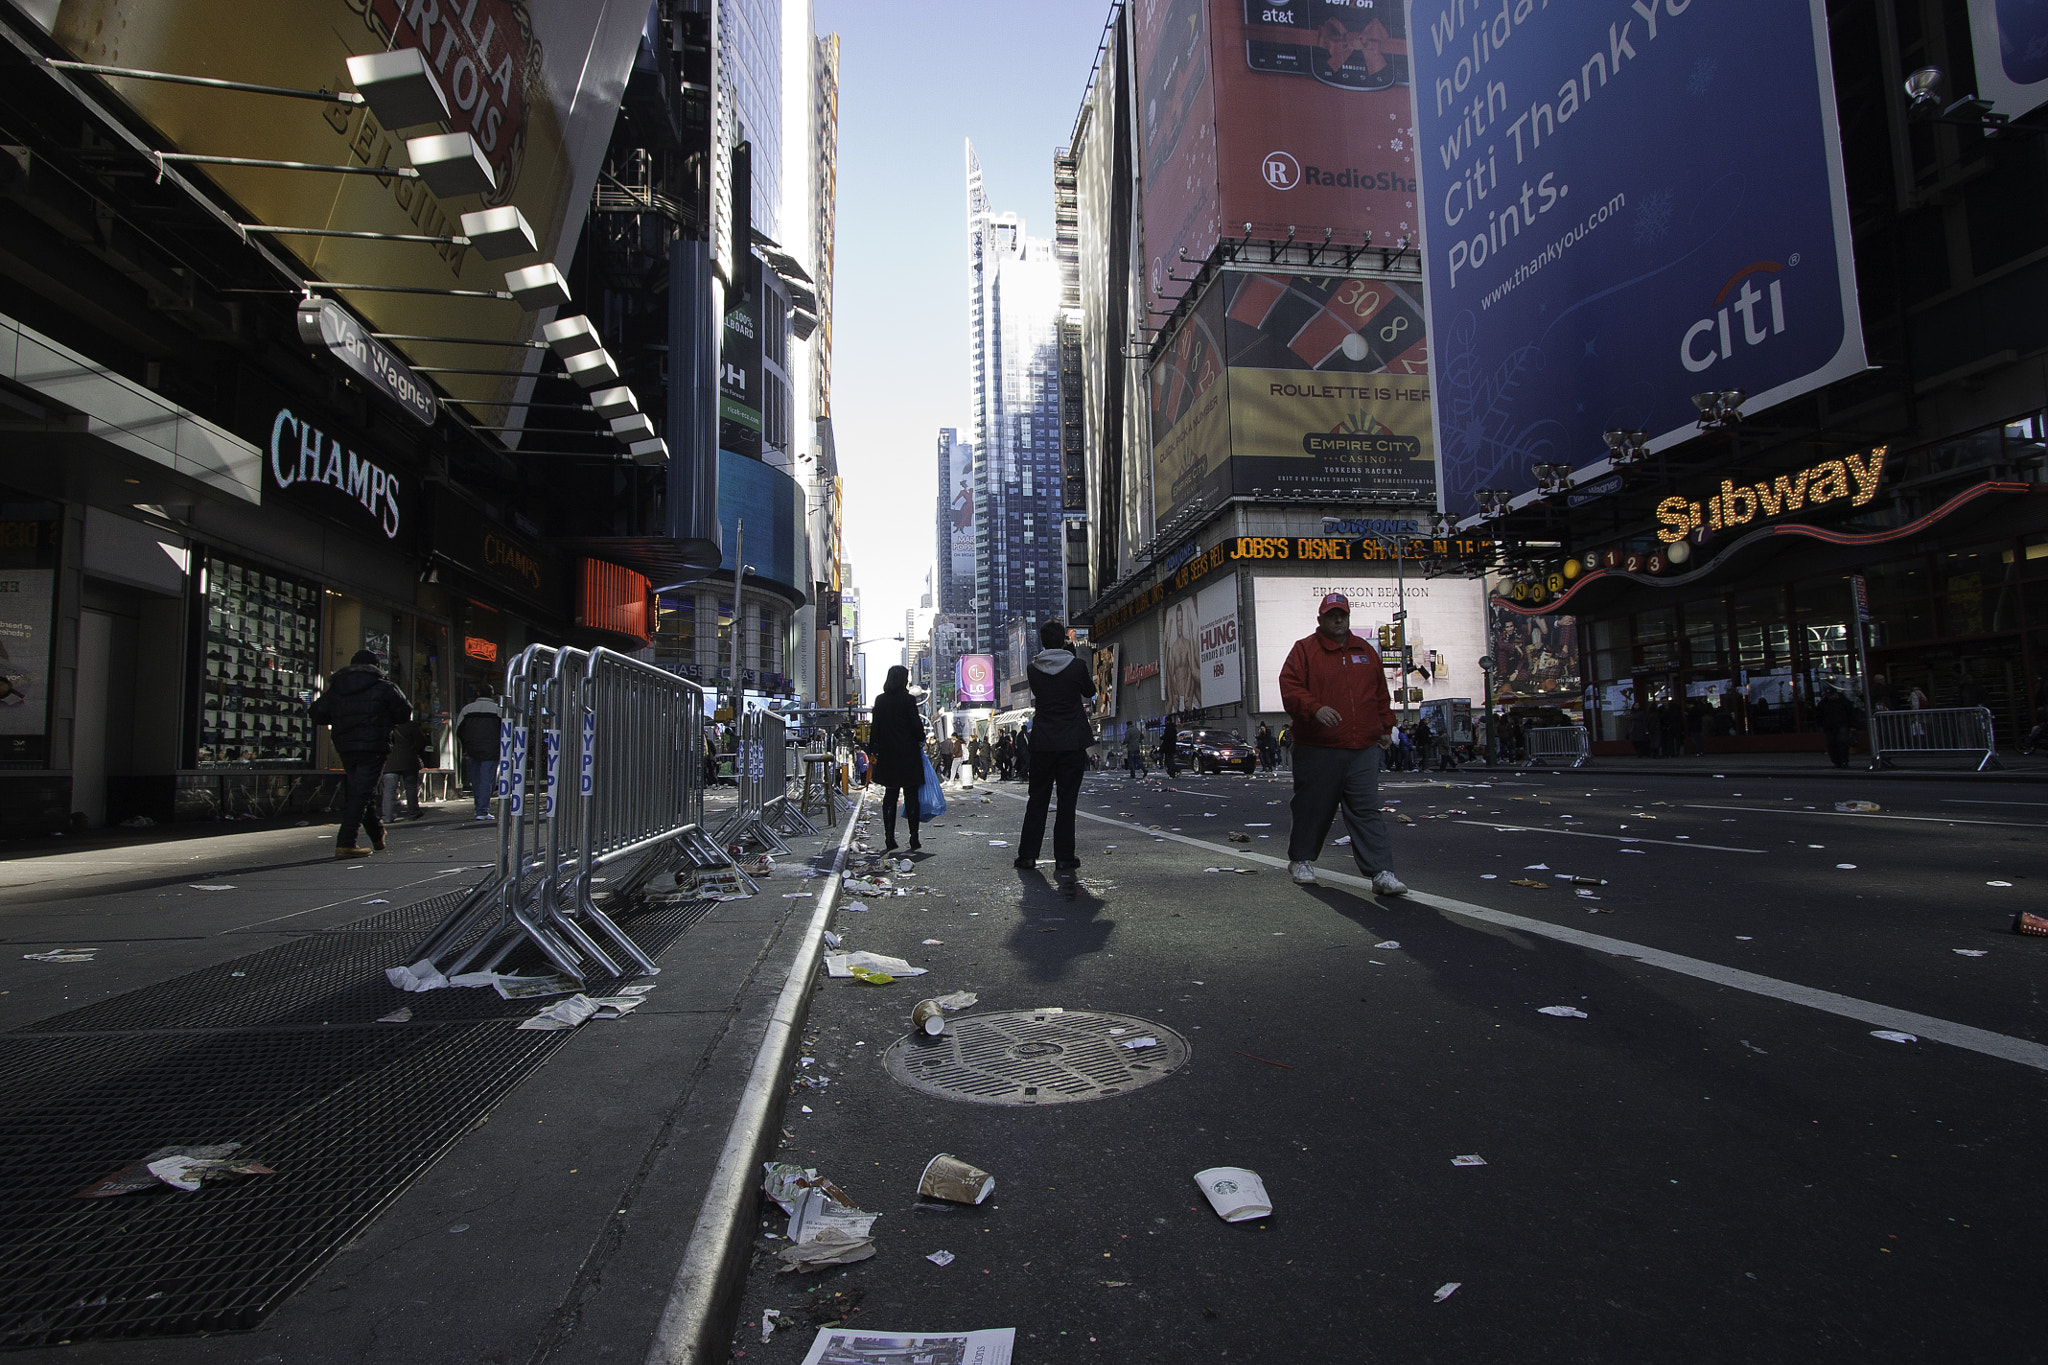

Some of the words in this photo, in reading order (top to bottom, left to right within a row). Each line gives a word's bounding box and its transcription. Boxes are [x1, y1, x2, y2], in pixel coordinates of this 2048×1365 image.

[1262, 8, 1295, 25] at&t
[397, 0, 502, 153] RTOIS
[1436, 0, 1548, 118] holida
[1440, 79, 1507, 171] with
[1445, 144, 1497, 227] Citi
[1448, 172, 1570, 290] Points.
[1481, 192, 1626, 311] www.thankyou.com
[1336, 279, 1380, 318] 30
[1379, 316, 1409, 343] 8
[1680, 278, 1786, 373] citi
[324, 304, 368, 365] Van
[371, 344, 433, 414] Wagner
[1269, 383, 1369, 400] ROULETTE
[1374, 387, 1391, 401] IS
[1310, 437, 1373, 452] EMPIRE
[1339, 454, 1387, 465] CASINO
[271, 408, 400, 539] CHAMPS
[1324, 466, 1362, 475] YONKERS
[1364, 467, 1403, 476] RACEWAY
[1655, 444, 1888, 543] Subway
[1230, 537, 1289, 560] JOBS'S
[1297, 538, 1350, 560] DISNEY
[1696, 526, 1705, 542] 7
[484, 533, 542, 590] CHAMPS
[1516, 586, 1525, 598] N
[1550, 577, 1558, 589] R
[1586, 553, 1596, 567] S
[1607, 551, 1615, 566] 1
[1627, 556, 1638, 571] 2
[1650, 557, 1660, 572] 3
[1377, 587, 1430, 599] BEAMON
[1200, 620, 1236, 653] HUNG
[1201, 649, 1219, 664] SUNDAYS
[1219, 647, 1225, 659] AT
[969, 684, 985, 694] LG
[1213, 663, 1225, 678] HBO
[499, 721, 512, 797] NYPD
[511, 730, 527, 812] NYPD
[546, 733, 560, 813] NYPD
[581, 713, 594, 792] NYPD
